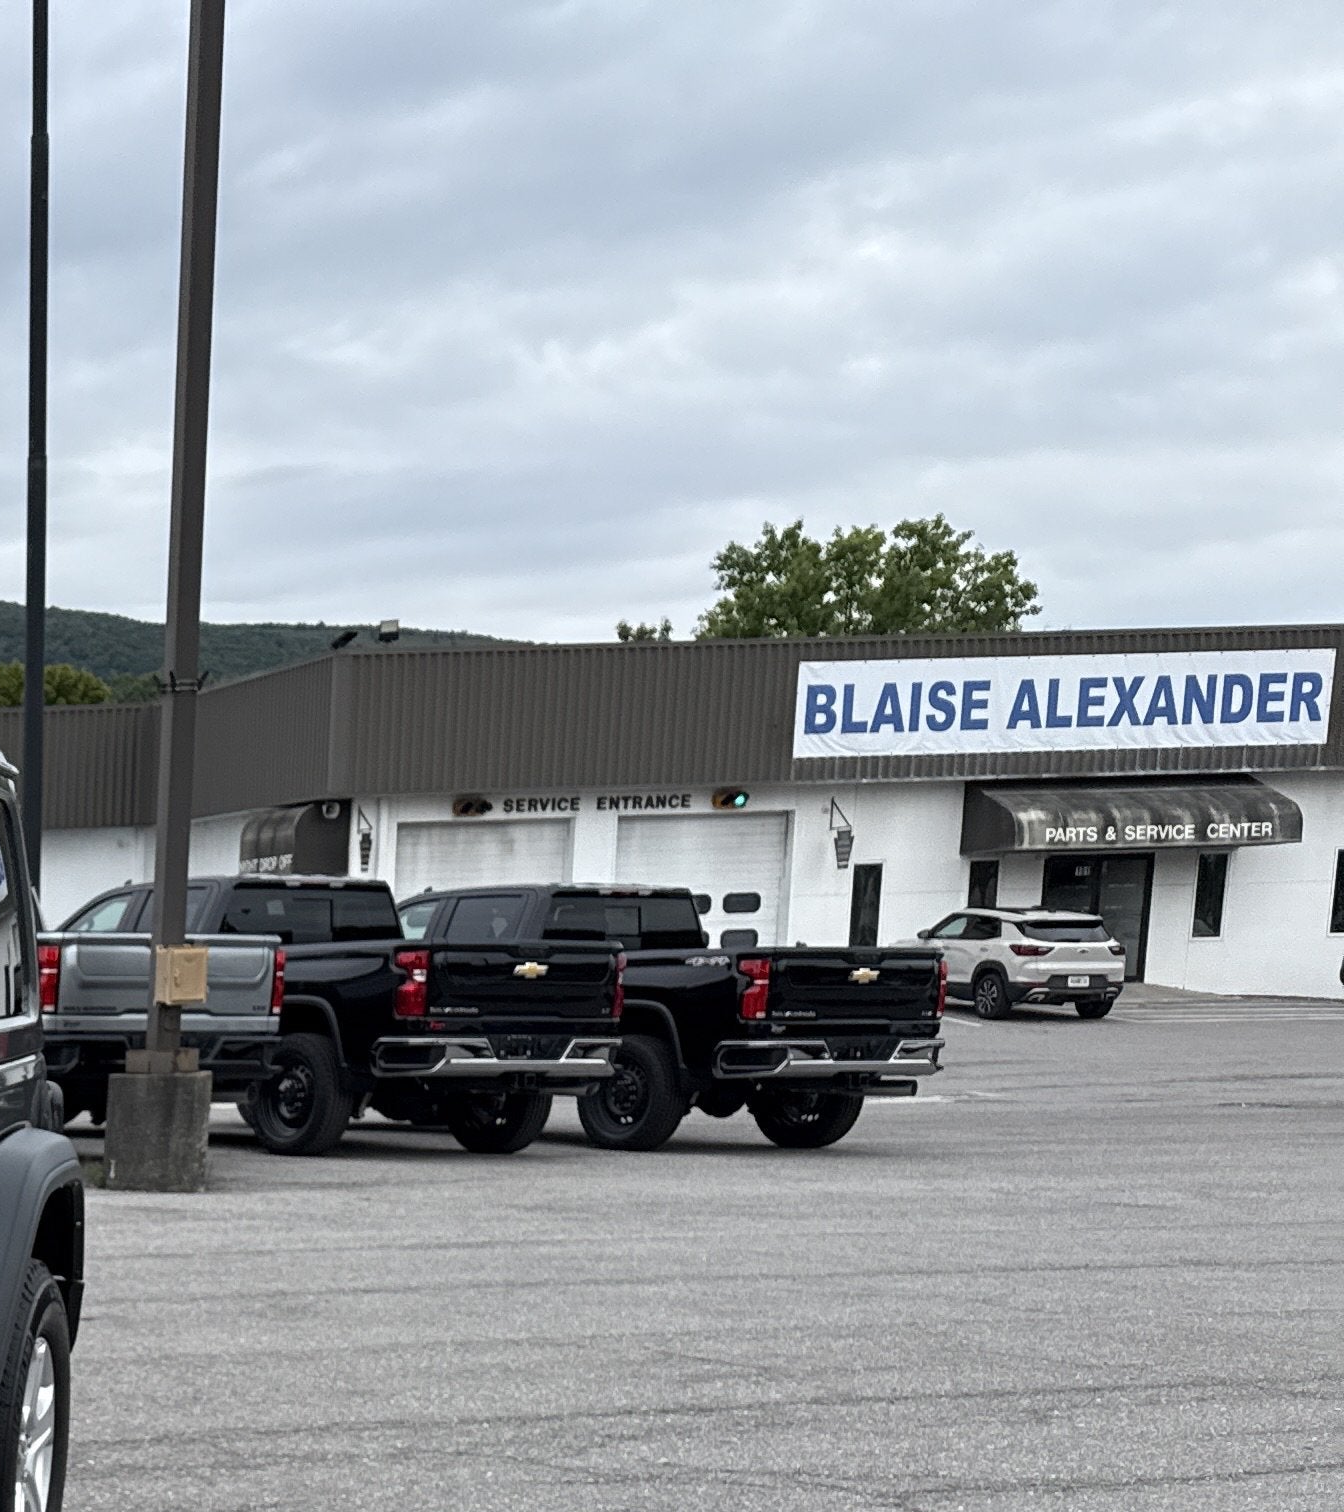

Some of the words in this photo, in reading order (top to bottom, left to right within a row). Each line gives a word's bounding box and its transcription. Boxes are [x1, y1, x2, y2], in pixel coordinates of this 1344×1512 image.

[803, 679, 992, 735] BLAISE
[1006, 671, 1323, 730] ALEXANDER
[503, 797, 581, 812] SERVICE
[596, 794, 692, 810] ENTRANCE
[1045, 826, 1098, 843] PARTS
[1105, 826, 1117, 841] &
[1124, 824, 1196, 840] SERVICE
[1206, 821, 1273, 839] CENTER
